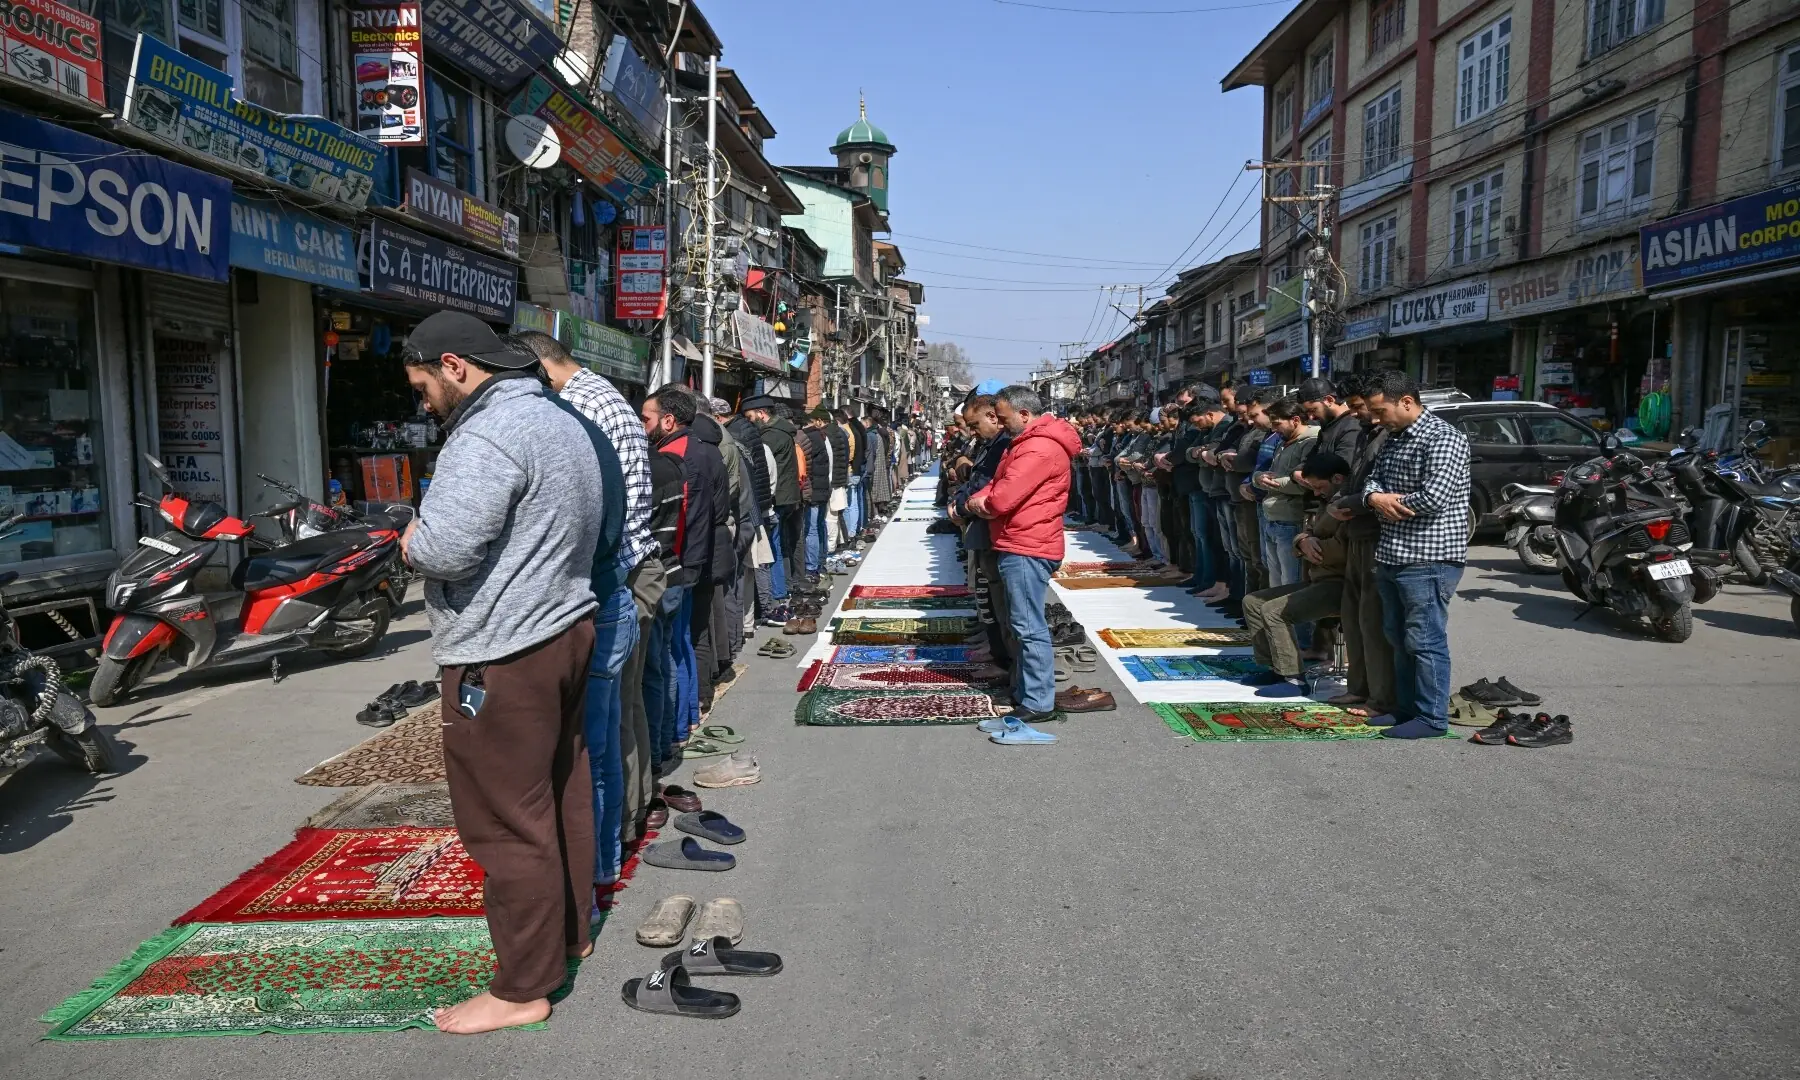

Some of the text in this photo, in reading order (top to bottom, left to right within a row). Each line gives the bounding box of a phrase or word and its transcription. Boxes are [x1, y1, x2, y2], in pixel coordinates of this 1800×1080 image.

[351, 30, 420, 42] Electronics
[352, 8, 417, 27] RIYAN
[454, 0, 538, 50] YAN
[531, 121, 548, 134] airte
[547, 91, 589, 134] BILAL
[267, 114, 377, 171] ELECTRONICS
[301, 150, 335, 172] REPAIRING
[0, 142, 212, 255] EPSON
[411, 177, 463, 226] RIYAN
[463, 197, 503, 227] Electronics
[294, 222, 346, 262] CARE
[1646, 215, 1736, 271] ASIAN
[1766, 199, 1800, 222] MO
[1739, 220, 1800, 249] CORPO
[264, 247, 356, 284] REFILLING CENTRE
[378, 239, 395, 277] S.
[399, 246, 416, 283] A.
[421, 253, 512, 308] ENTERPRISES
[1498, 250, 1624, 310] PARIS IRON
[405, 285, 495, 315] ALL TYPES OF MACHINERY GOODS
[1391, 292, 1448, 328] LUCKY
[1448, 283, 1487, 302] HARDWARE
[1452, 301, 1476, 317] STORE
[175, 374, 213, 384] SYSTEMS
[159, 430, 220, 441] RONIC GOODS
[308, 503, 339, 520] PRESS
